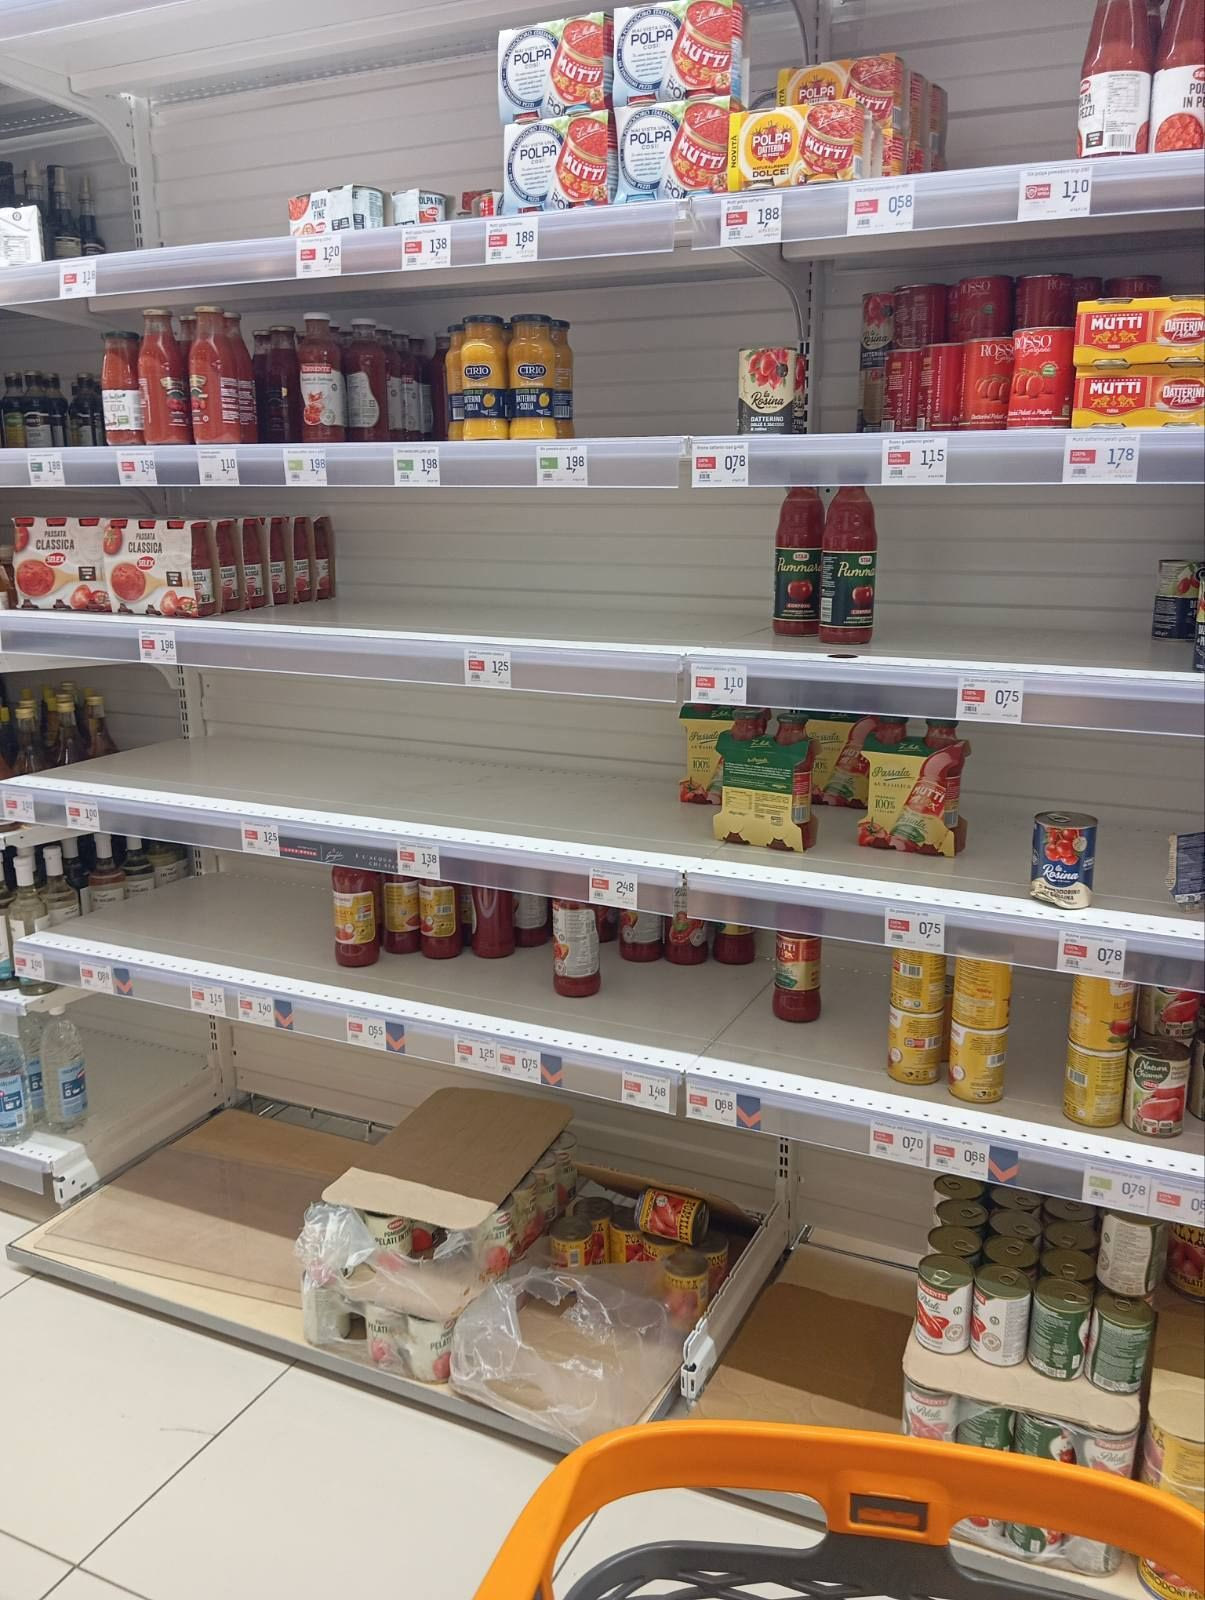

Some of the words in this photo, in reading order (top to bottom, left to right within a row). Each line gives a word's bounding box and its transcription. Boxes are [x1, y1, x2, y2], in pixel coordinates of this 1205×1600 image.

[631, 29, 674, 46] POLPA
[513, 48, 552, 65] POLPA
[680, 32, 730, 68] MUTTI
[557, 54, 602, 83] MUTTI
[799, 85, 835, 100] POLPA
[630, 130, 672, 145] POLPA
[752, 132, 791, 147] POLPA
[520, 144, 557, 160] POLPA
[678, 135, 726, 168] MUTTI
[804, 137, 848, 159] MUTTI
[562, 151, 606, 180] MUTTI
[752, 168, 789, 178] DOLCE!
[1061, 179, 1089, 202] 1,10
[888, 194, 913, 216] 0,58
[756, 207, 780, 228] 1,88
[429, 238, 448, 257] 1,38
[515, 230, 534, 249] 1,88
[323, 246, 340, 263] 1,20
[1090, 316, 1143, 331] MUTTI
[465, 367, 489, 375] CIRIO
[519, 366, 545, 374] CIRIO
[1089, 381, 1141, 394] MUTTI
[751, 391, 784, 409] Rosina
[220, 458, 236, 474] 1,10
[309, 458, 326, 474] 1,98
[566, 455, 584, 473] 1,98
[725, 455, 746, 473] 0,78
[920, 449, 944, 469] 1,15
[1106, 448, 1135, 468] 1,78
[420, 458, 438, 475] 1,98
[36, 538, 75, 550] CLASSICA
[128, 542, 163, 554] CLASSICA
[160, 640, 174, 654] 1,98
[492, 661, 509, 676] 1,25
[723, 677, 744, 694] 1,10
[995, 690, 1019, 708] 0,75
[872, 766, 911, 778] Passata
[875, 799, 896, 810] 100%
[263, 831, 278, 845] 1,25
[421, 853, 437, 868] 1,38
[1042, 863, 1079, 882] Rosina
[616, 881, 634, 896] 2,48
[919, 921, 941, 939] 0,75
[1097, 947, 1122, 965] 0,78
[368, 1025, 383, 1039] 0,55
[479, 1048, 495, 1062] 1,25
[521, 1057, 538, 1072] 0,75
[1140, 1060, 1169, 1073] Natura
[648, 1084, 666, 1100] 1,48
[714, 1098, 733, 1113] 0,68
[902, 1135, 923, 1152] 0,70
[964, 1149, 986, 1165] 0,68
[1121, 1182, 1146, 1199] 0,78
[368, 1323, 388, 1334] PELATI
